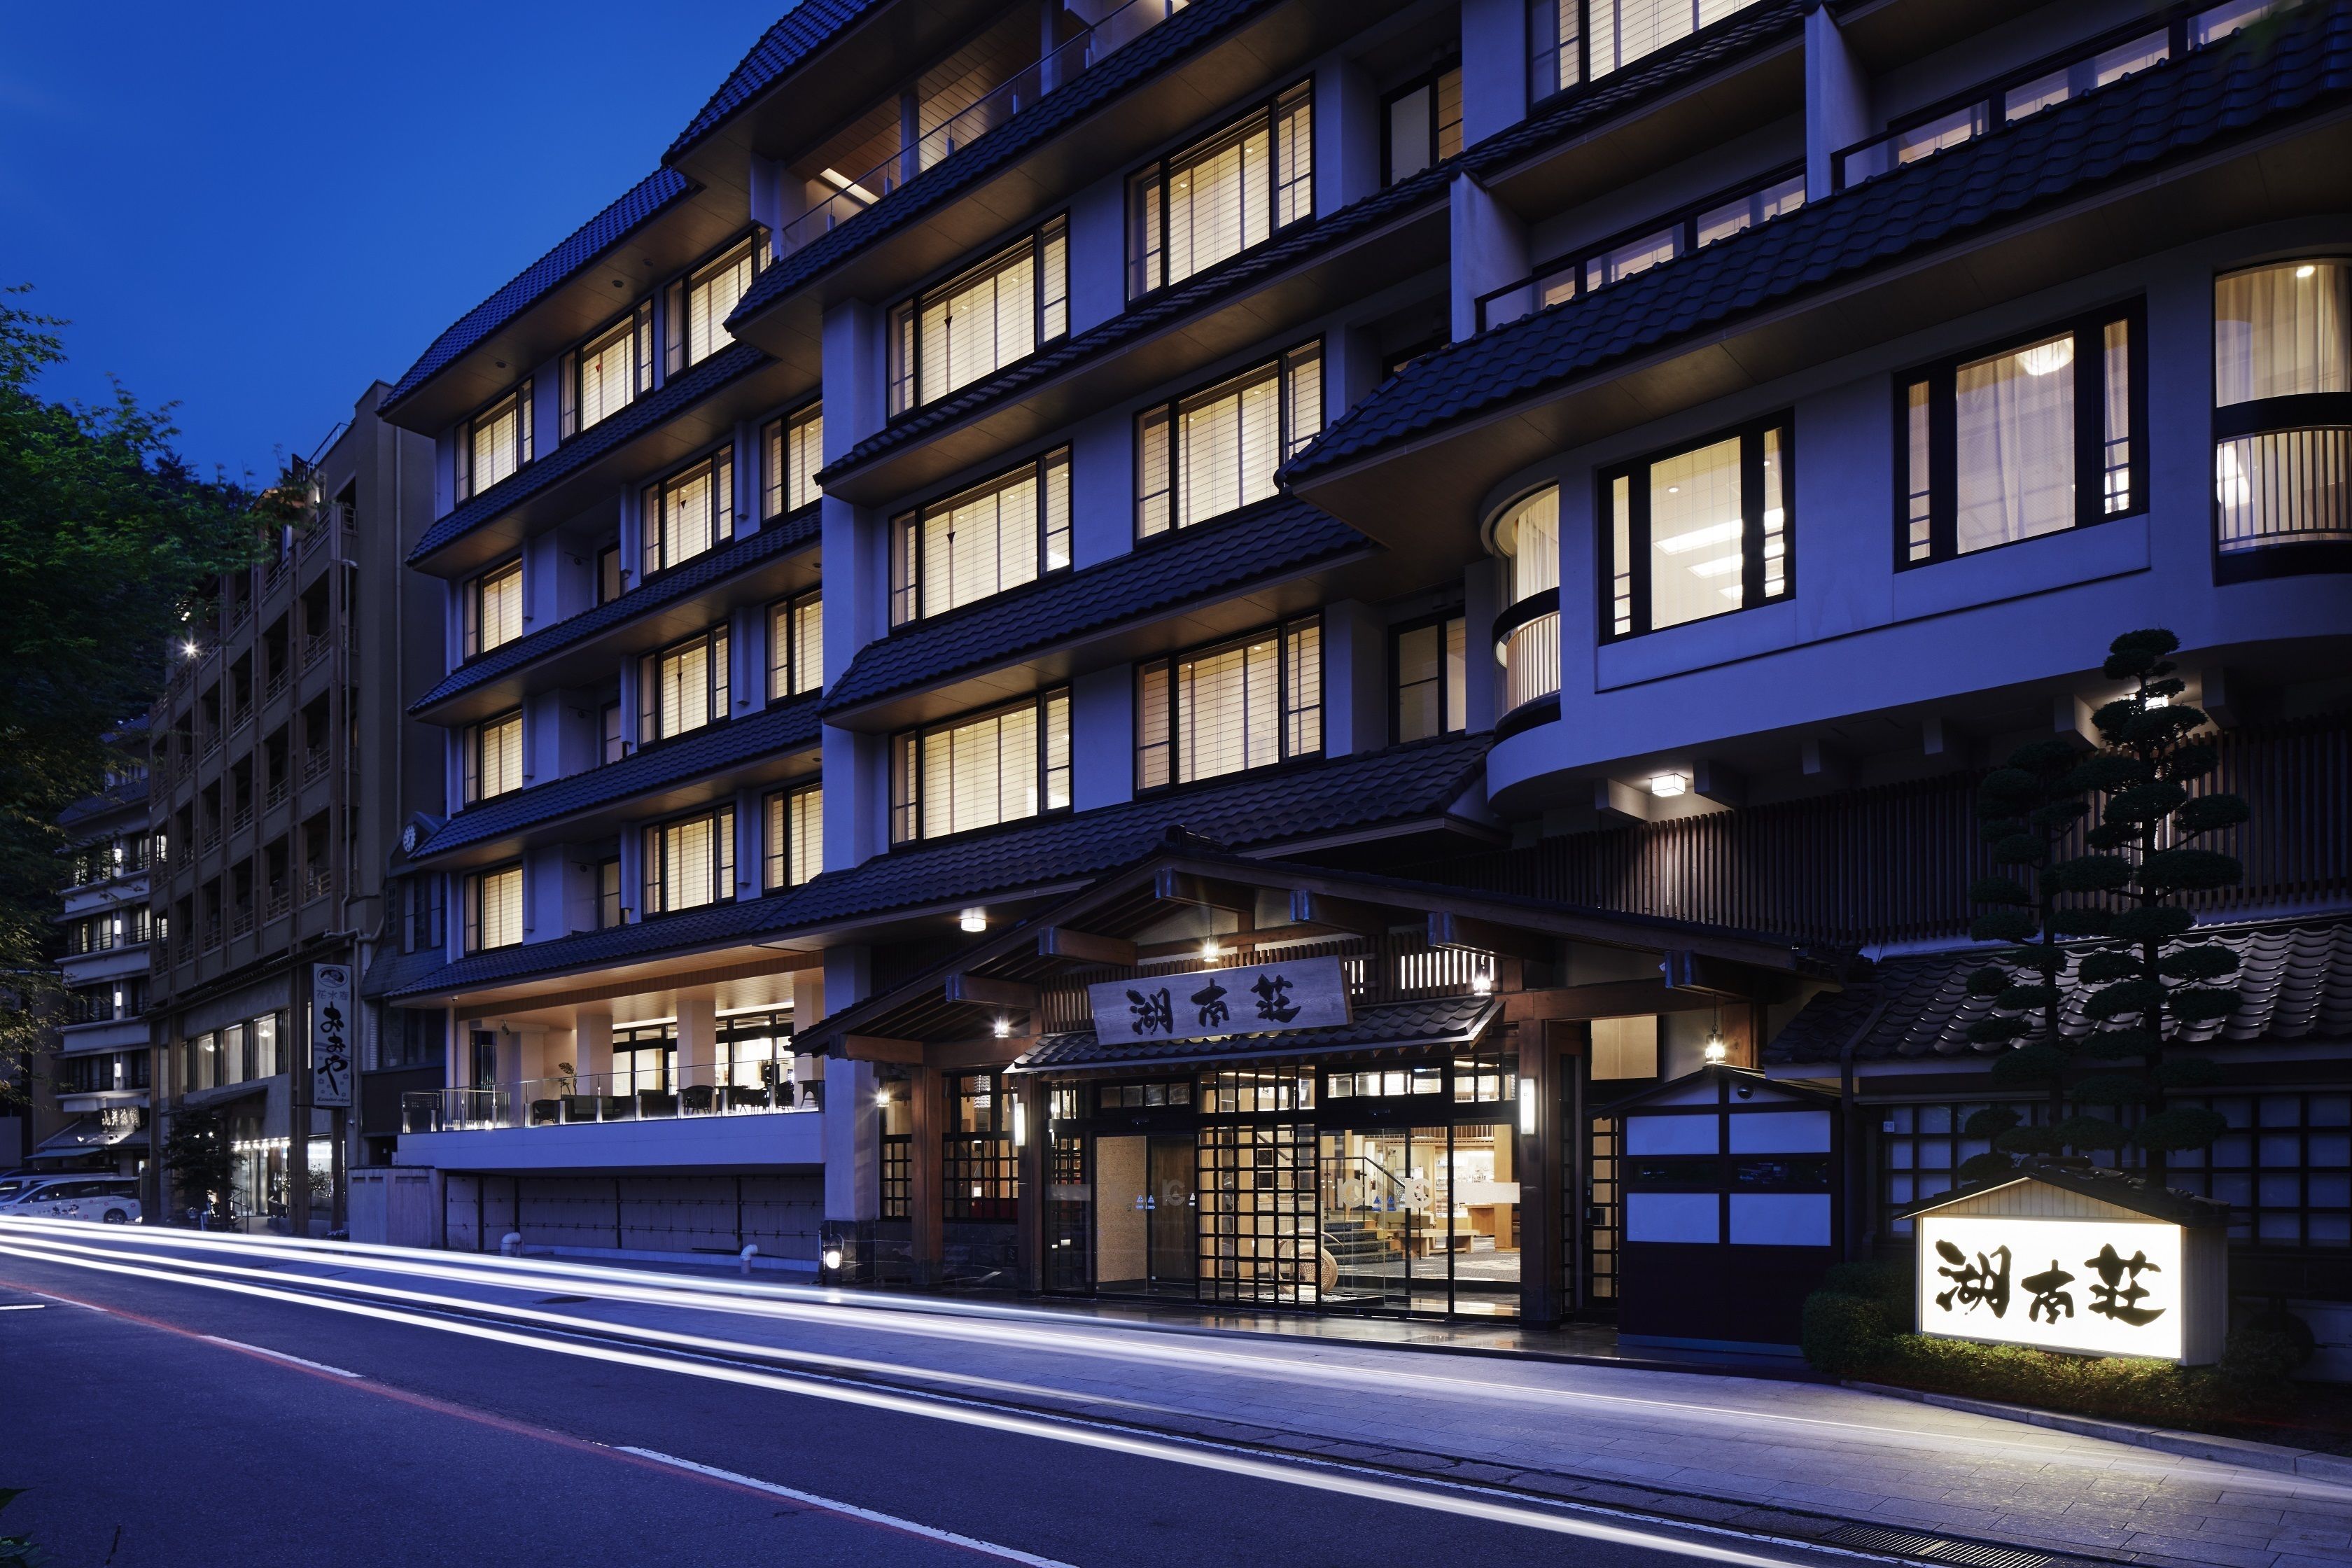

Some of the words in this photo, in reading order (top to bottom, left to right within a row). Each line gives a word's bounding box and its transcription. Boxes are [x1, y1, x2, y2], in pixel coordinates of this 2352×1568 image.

[317, 1001, 348, 1096] おおや
[1126, 974, 1301, 1035] 湖南荘
[1935, 1238, 2167, 1327] 湖南荘
